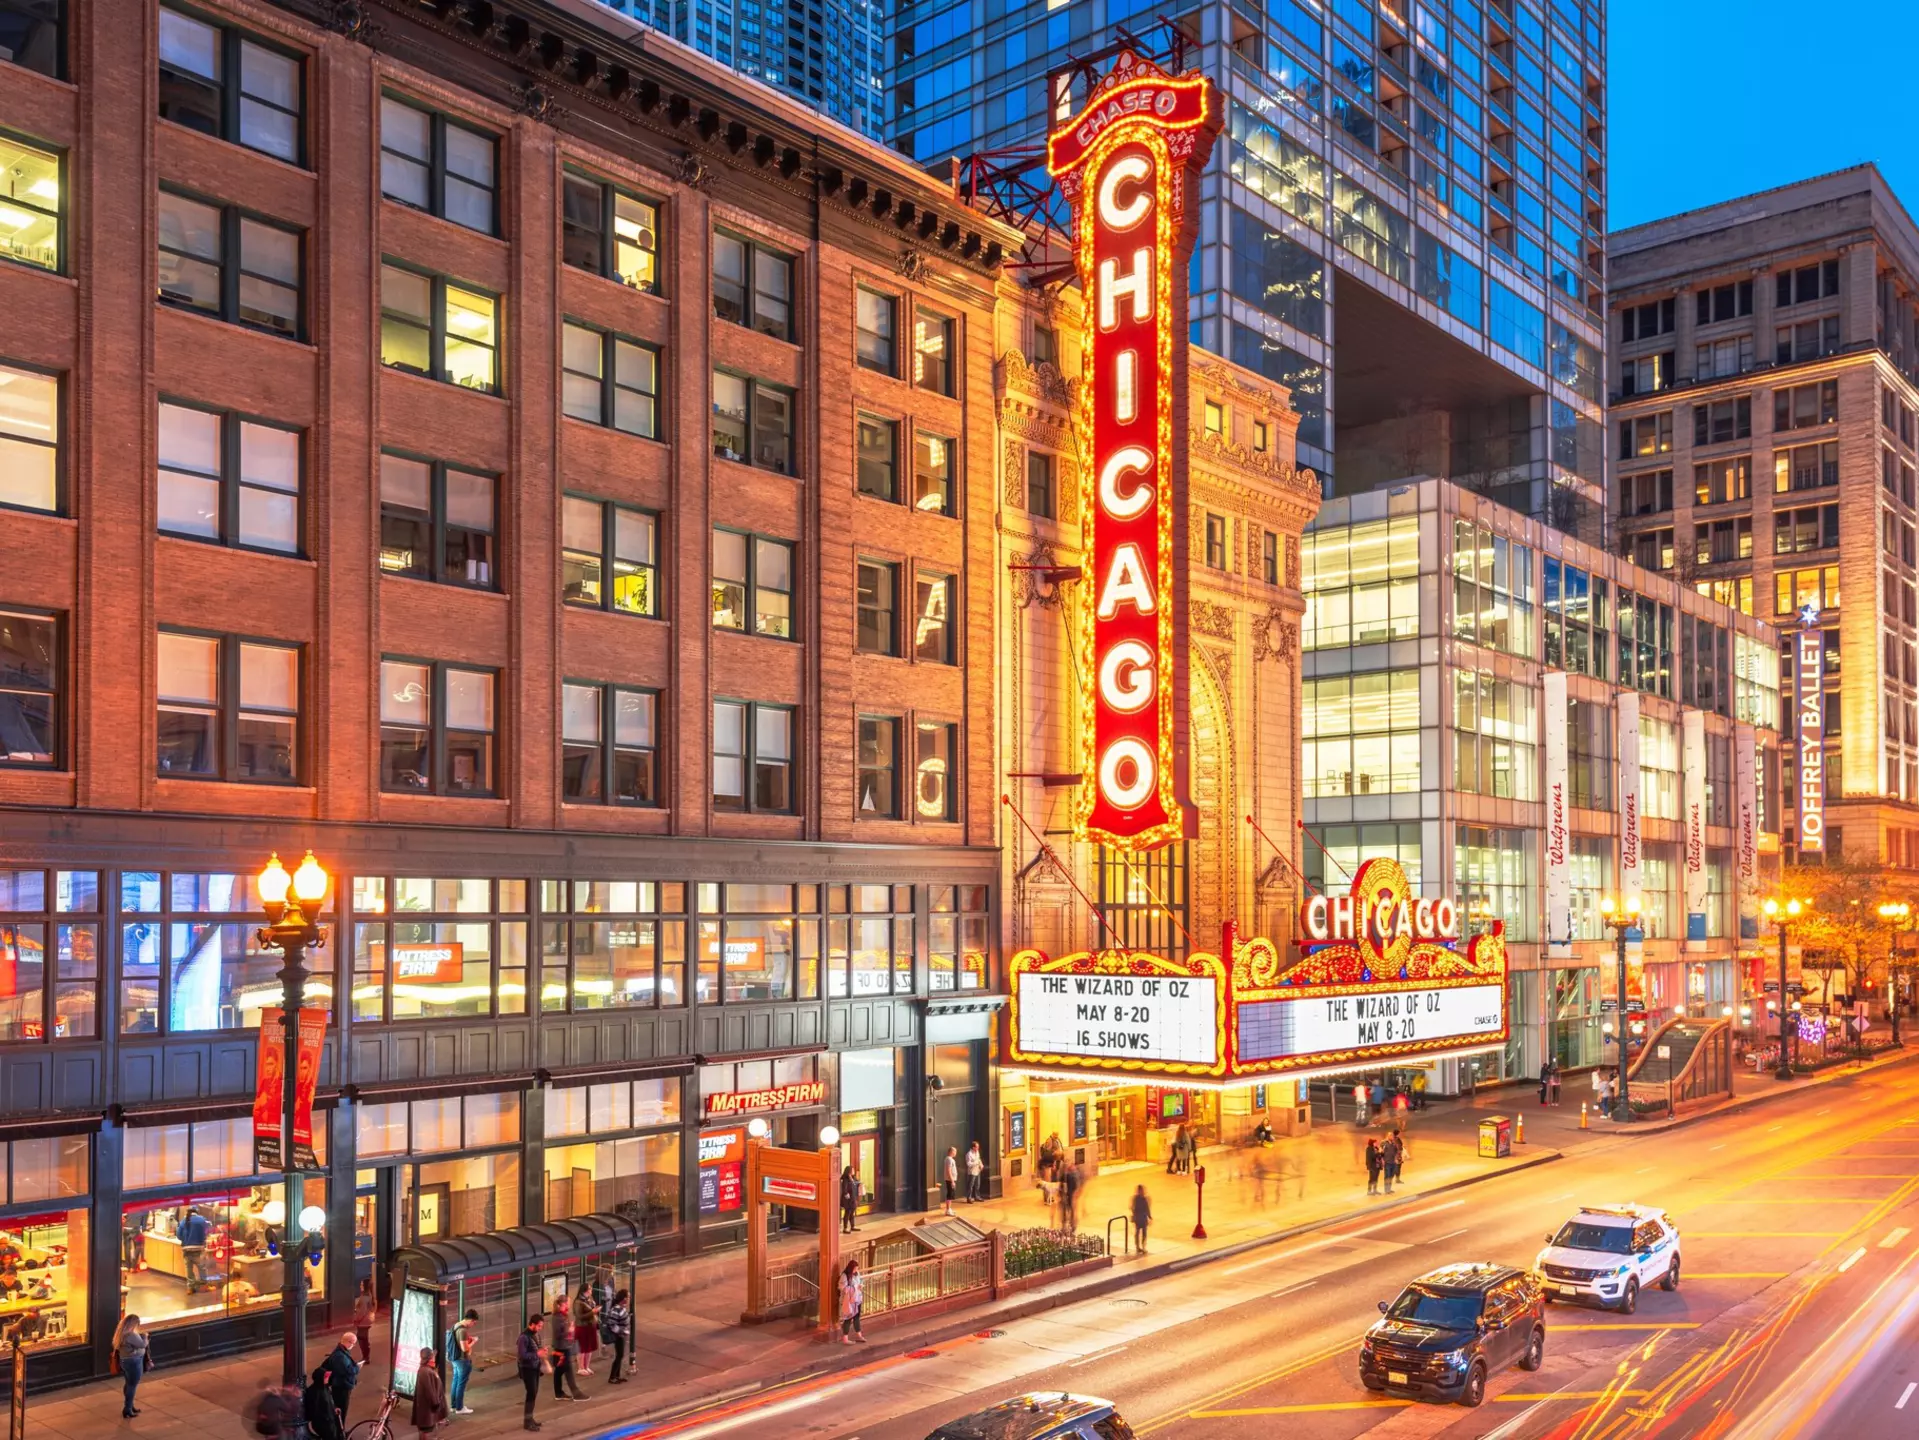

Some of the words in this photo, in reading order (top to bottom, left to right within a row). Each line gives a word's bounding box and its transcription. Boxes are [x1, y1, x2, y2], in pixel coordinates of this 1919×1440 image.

[1076, 90, 1154, 146] CHASE
[1098, 154, 1157, 811] CHICAGO
[1801, 635, 1821, 728] BALLET
[1802, 733, 1823, 848] JOFFREY
[1550, 782, 1567, 867] Walgreens
[1624, 793, 1639, 870] Walgreens
[1689, 803, 1703, 874] Walgreens
[1741, 811, 1756, 878] Walgreens
[1307, 894, 1456, 940] CHICAGO
[1041, 977, 1068, 993] THE
[1075, 978, 1134, 996] WIZARD
[1142, 980, 1160, 997] OF
[1169, 981, 1189, 998] OZ
[1077, 1004, 1107, 1021] MAY
[1114, 1006, 1150, 1023] 8-20
[1327, 1000, 1348, 1022] THE
[1356, 995, 1400, 1020] WIZARD
[1406, 994, 1419, 1015] OF
[1427, 992, 1441, 1012] OZ
[1474, 1014, 1492, 1026] CHASE
[1077, 1030, 1090, 1046] 16
[1098, 1031, 1150, 1050] SHOWS
[1358, 1022, 1380, 1044] MAY
[700, 1168, 717, 1179] purple
[720, 1177, 740, 1186] BRANDS
[724, 1192, 736, 1200] SALE
[726, 1185, 734, 1193] ON
[420, 1208, 432, 1220] M
